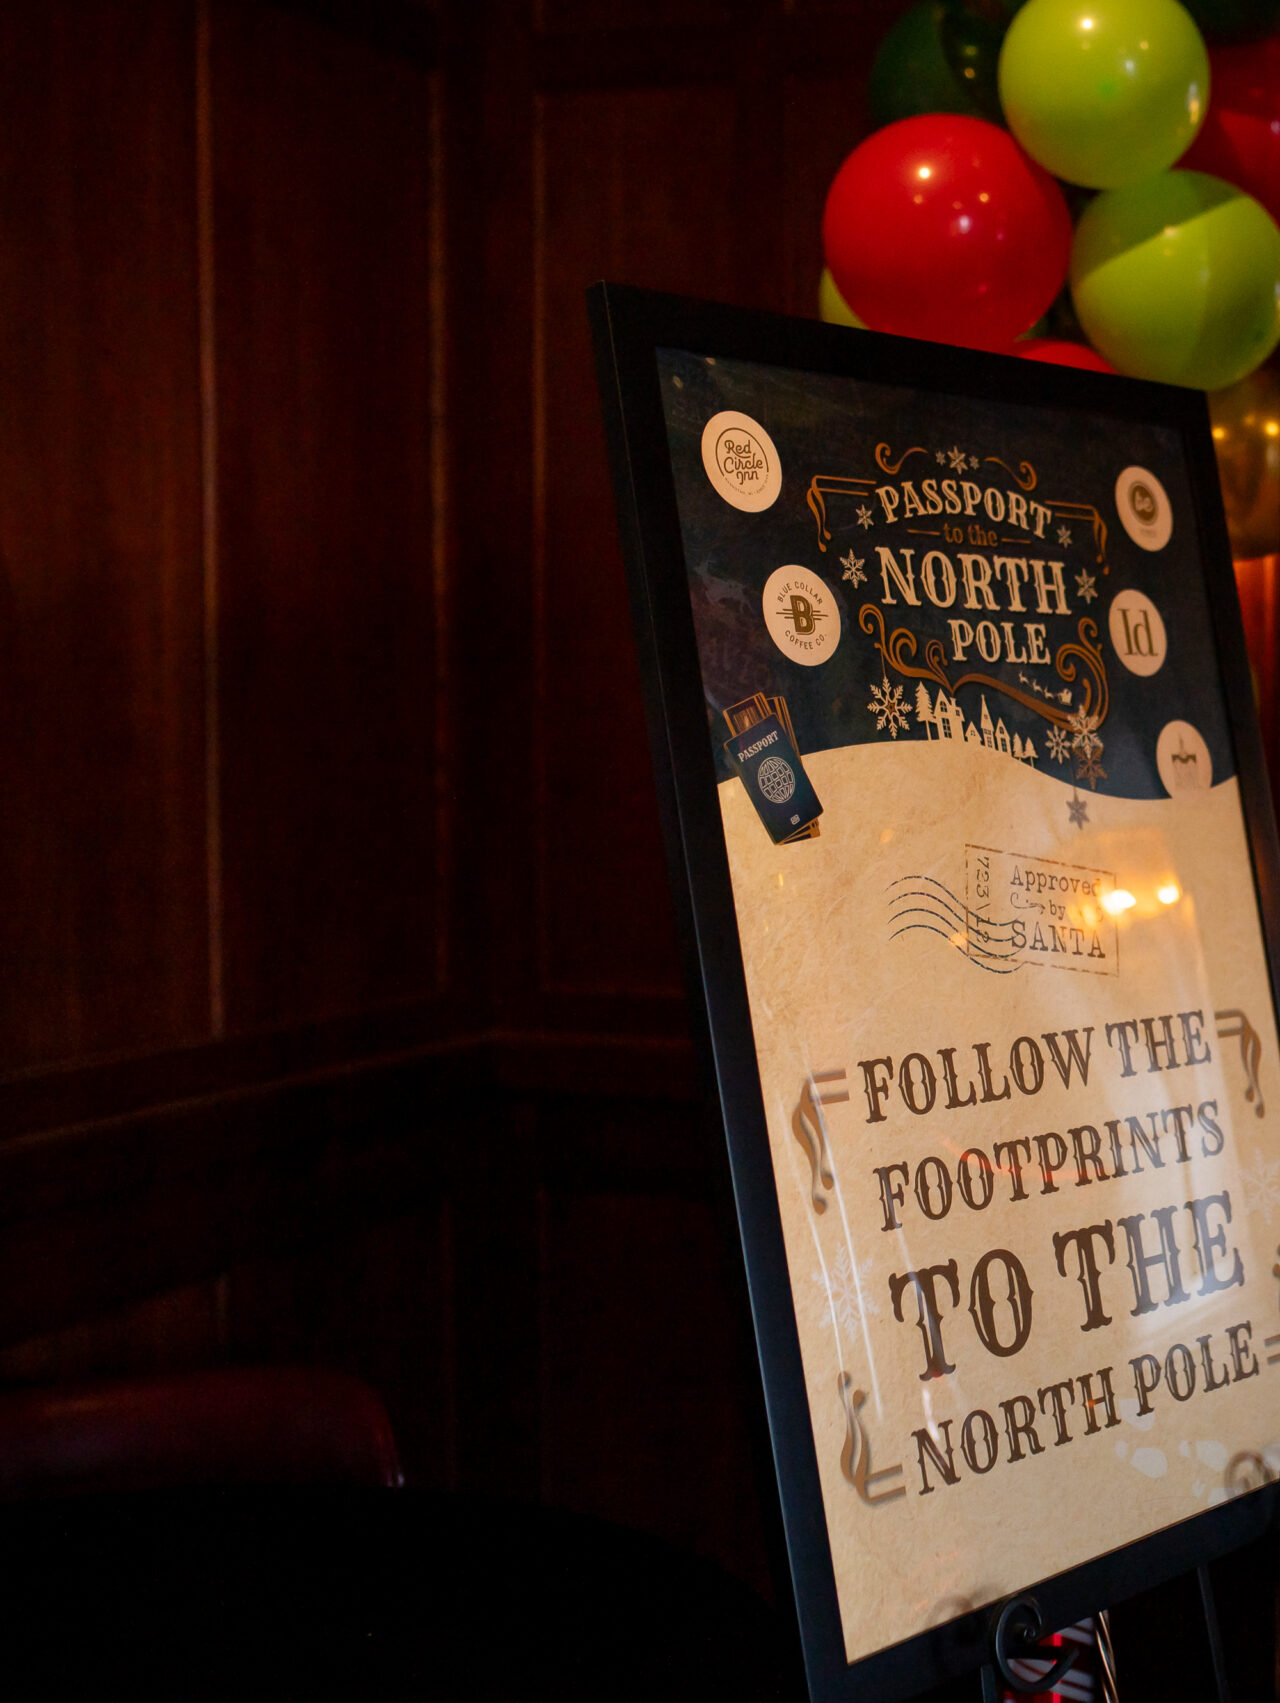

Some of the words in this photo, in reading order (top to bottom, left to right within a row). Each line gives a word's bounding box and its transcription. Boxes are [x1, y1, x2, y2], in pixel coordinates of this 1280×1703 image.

[723, 453, 764, 474] Circle
[724, 439, 752, 458] Red
[736, 471, 760, 485] Inn
[875, 479, 1052, 539] PASSPORT
[943, 523, 964, 544] to
[967, 524, 998, 547] the
[777, 582, 793, 603] BLUE
[794, 581, 823, 605] COLLAR
[874, 546, 1072, 615] NORTH
[790, 595, 816, 636] B
[784, 629, 814, 650] COFFEE
[947, 619, 1051, 665] POLE
[737, 730, 779, 763] PASSPORT
[1049, 899, 1066, 920] by
[1011, 919, 1106, 959] SANTA
[857, 1026, 1095, 1124] FOLLOW
[1104, 1009, 1212, 1078] THE
[872, 1098, 1224, 1232] FOOTPRINTS
[888, 1248, 1034, 1382] TO
[1052, 1190, 1245, 1332] THE
[911, 1366, 1122, 1496] NORTH
[1129, 1320, 1260, 1417] POLE
